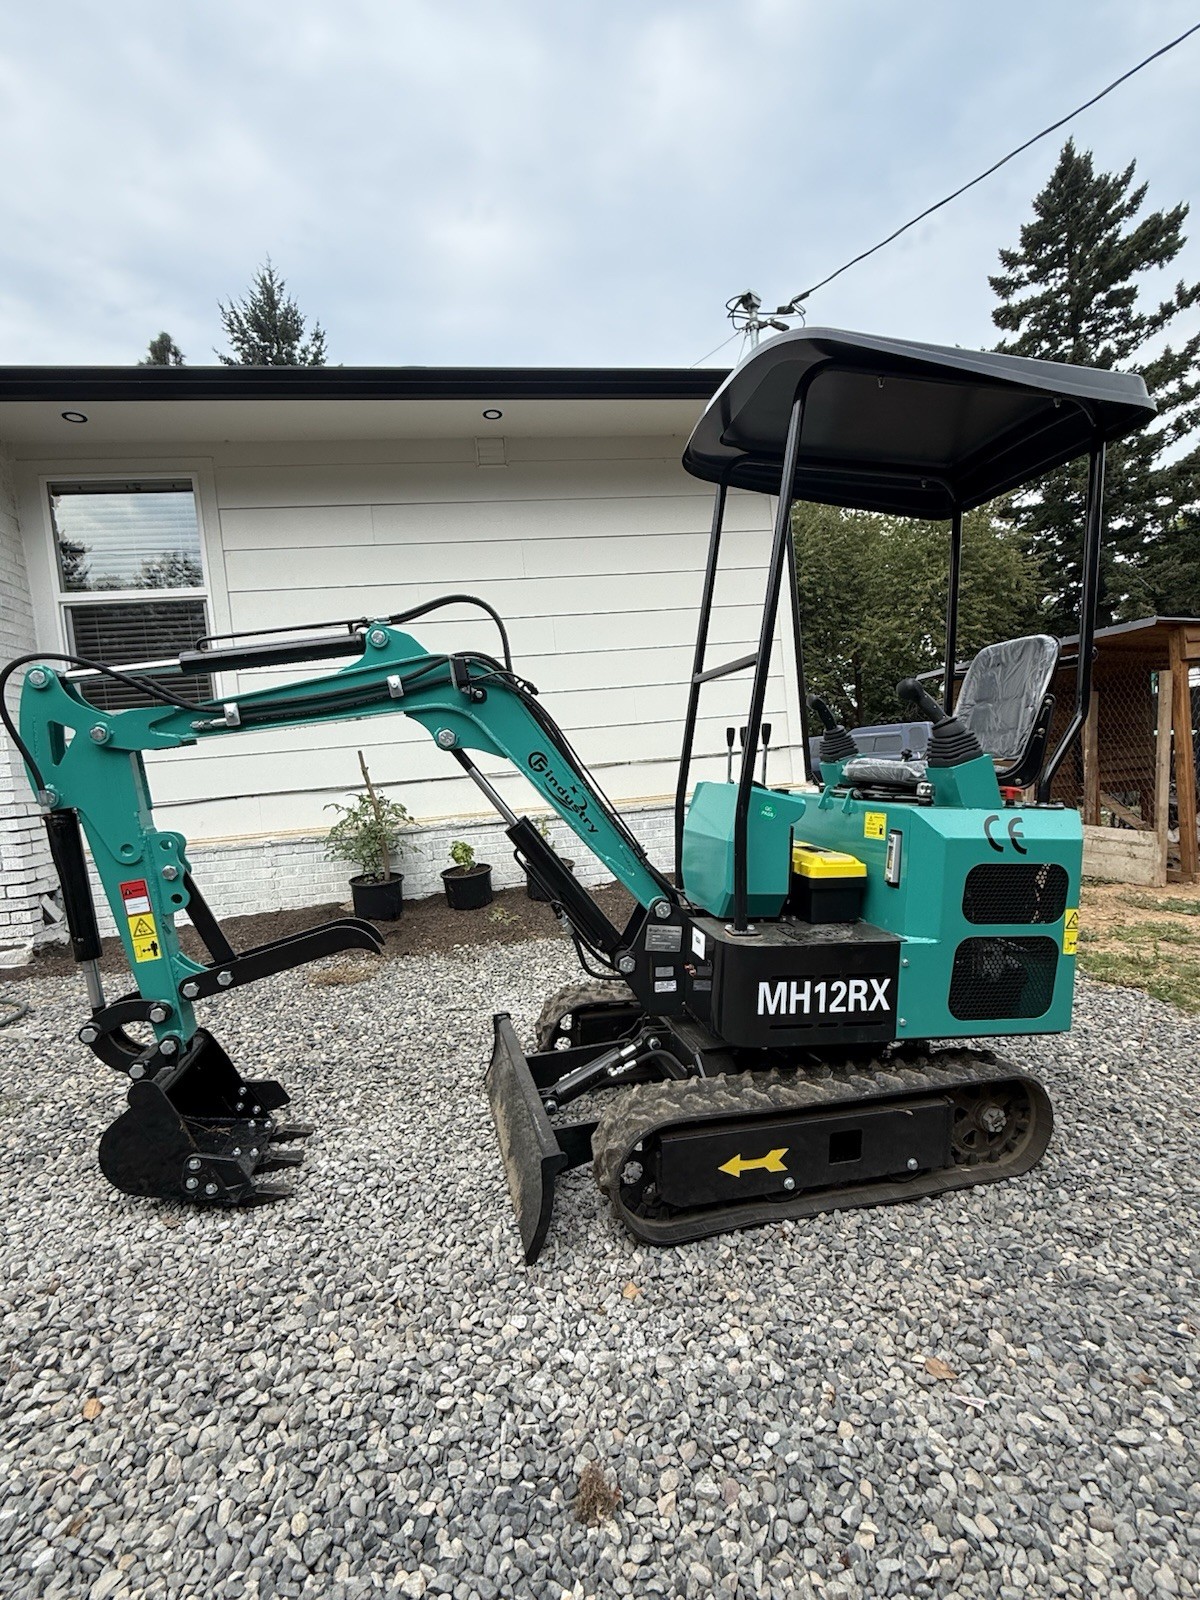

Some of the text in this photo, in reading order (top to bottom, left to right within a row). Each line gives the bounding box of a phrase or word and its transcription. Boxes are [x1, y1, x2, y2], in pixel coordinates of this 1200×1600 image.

[544, 770, 599, 833] industry
[984, 815, 1027, 855] CE
[757, 978, 891, 1015] MH12RX
